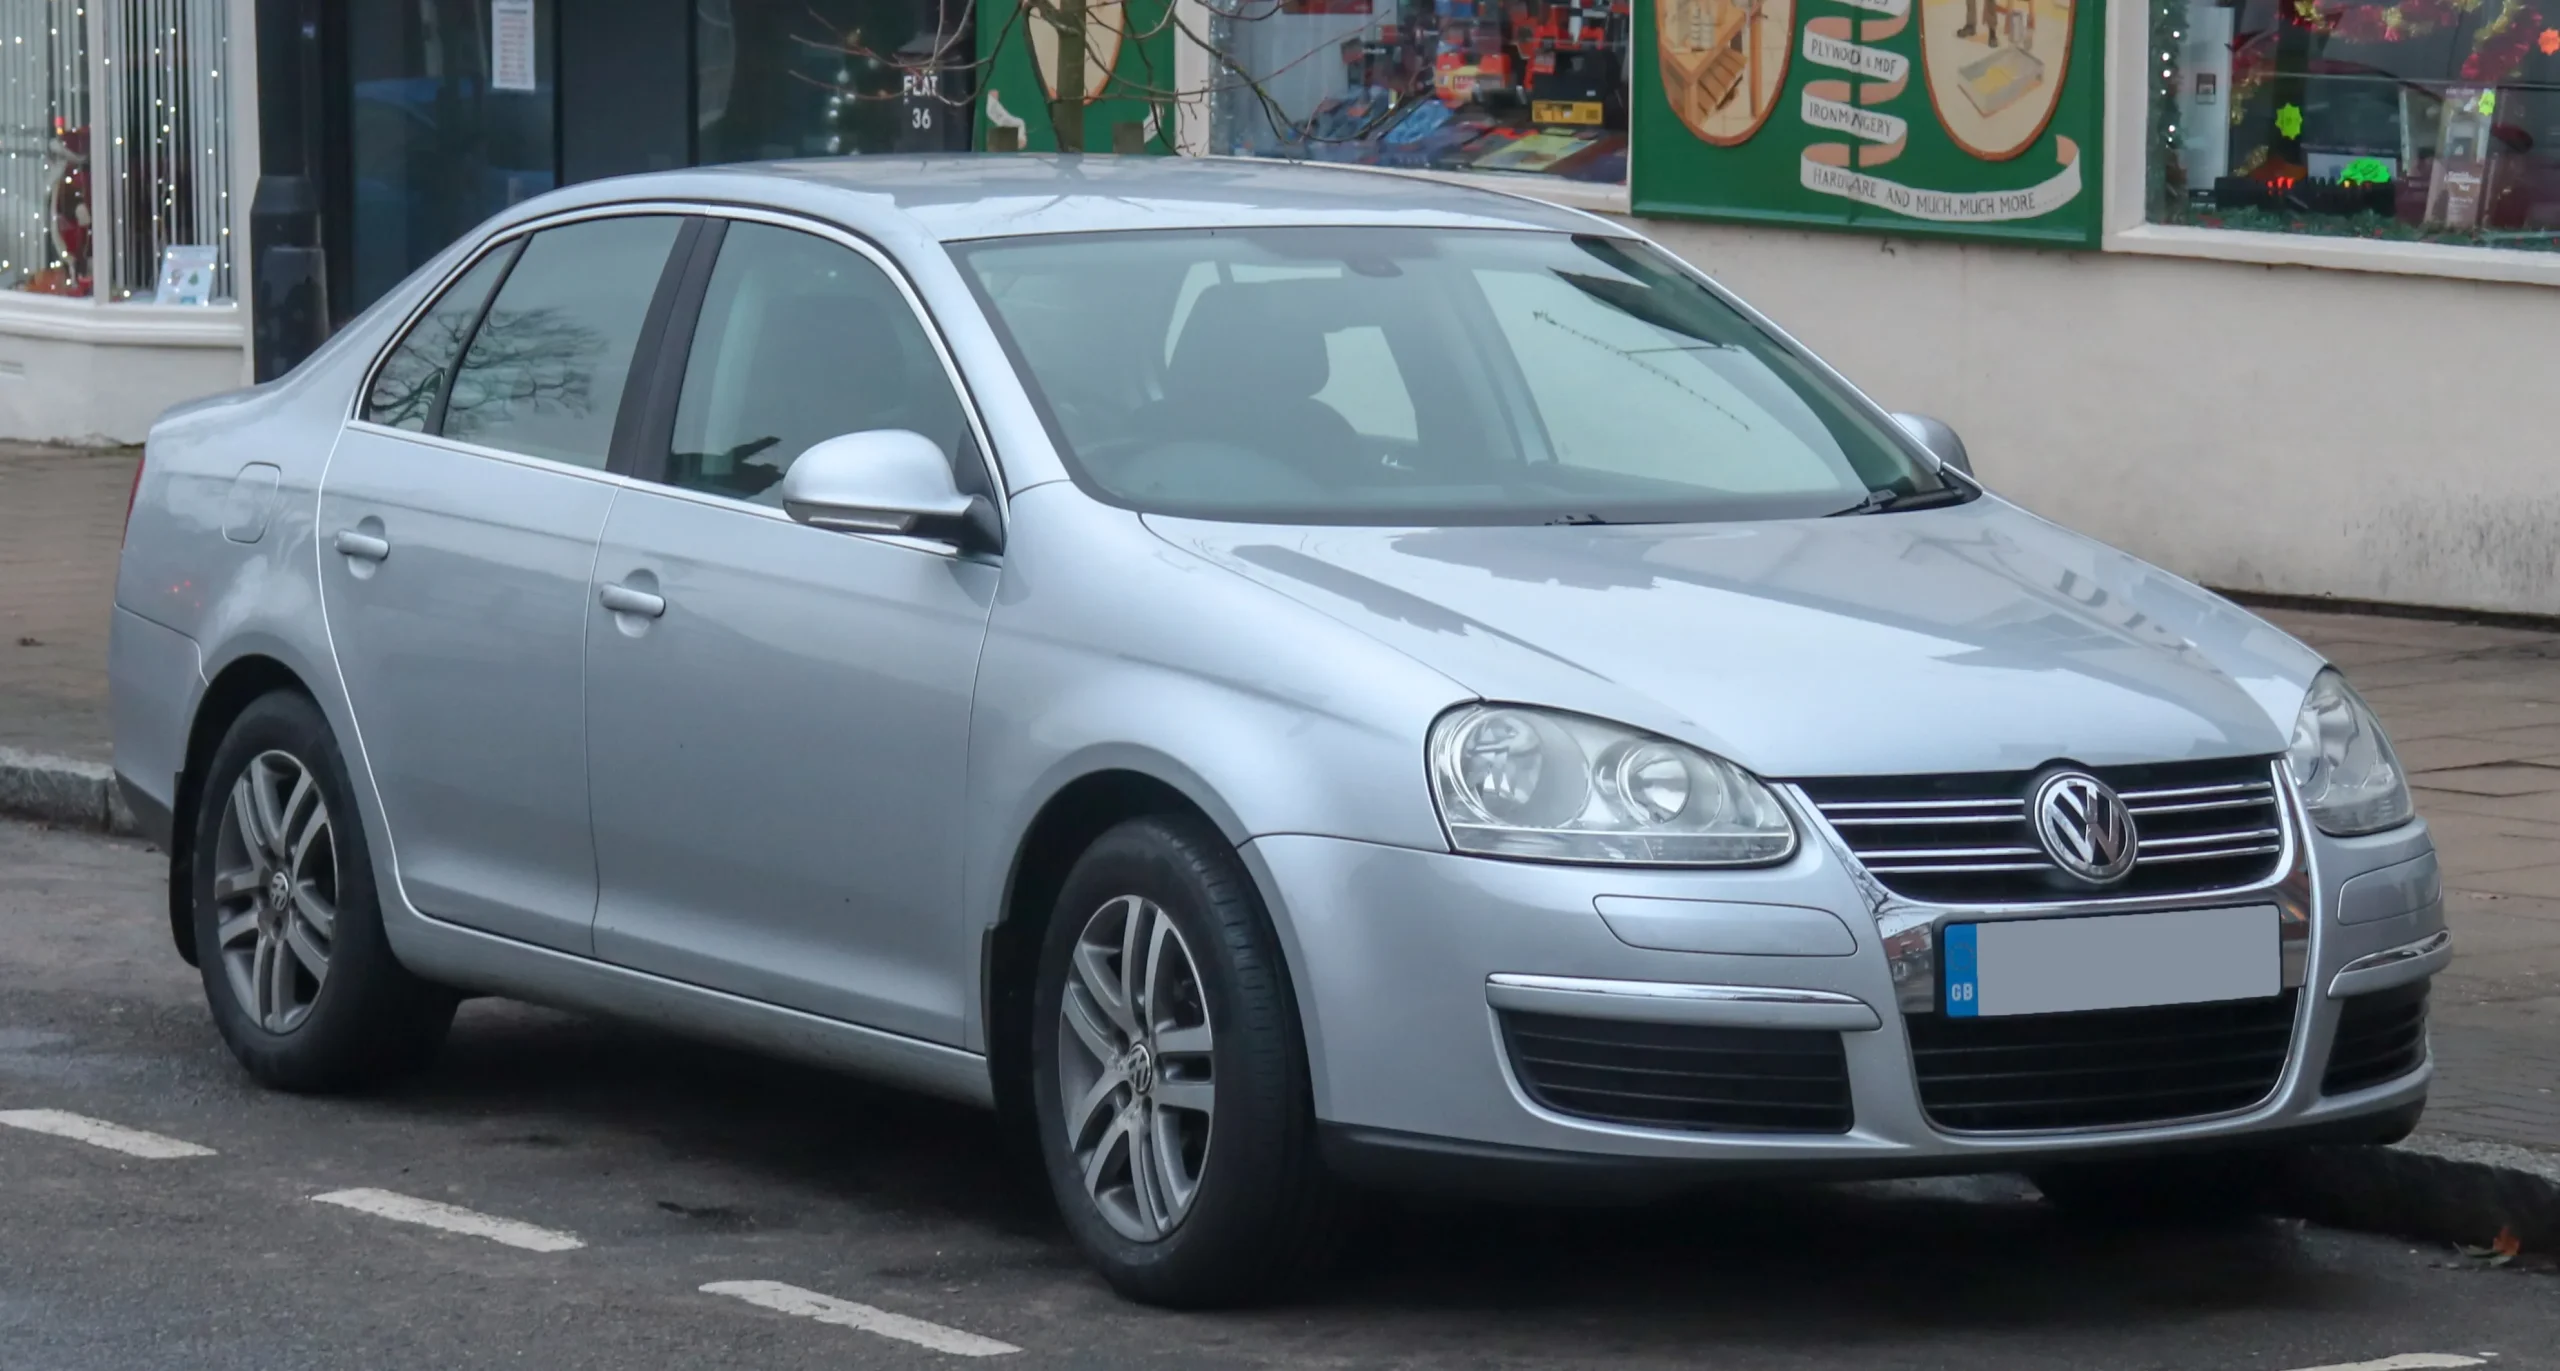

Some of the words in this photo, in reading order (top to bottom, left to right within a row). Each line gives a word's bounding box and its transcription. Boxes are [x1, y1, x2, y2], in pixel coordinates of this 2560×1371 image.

[1874, 56, 1897, 75] MDF
[904, 75, 938, 97] FLAT
[912, 107, 931, 129] 36
[1809, 101, 1893, 138] IRONMNGERY
[1813, 167, 1877, 199] HARDARE
[1884, 187, 1911, 209] AND
[1951, 982, 1973, 1002] GB
